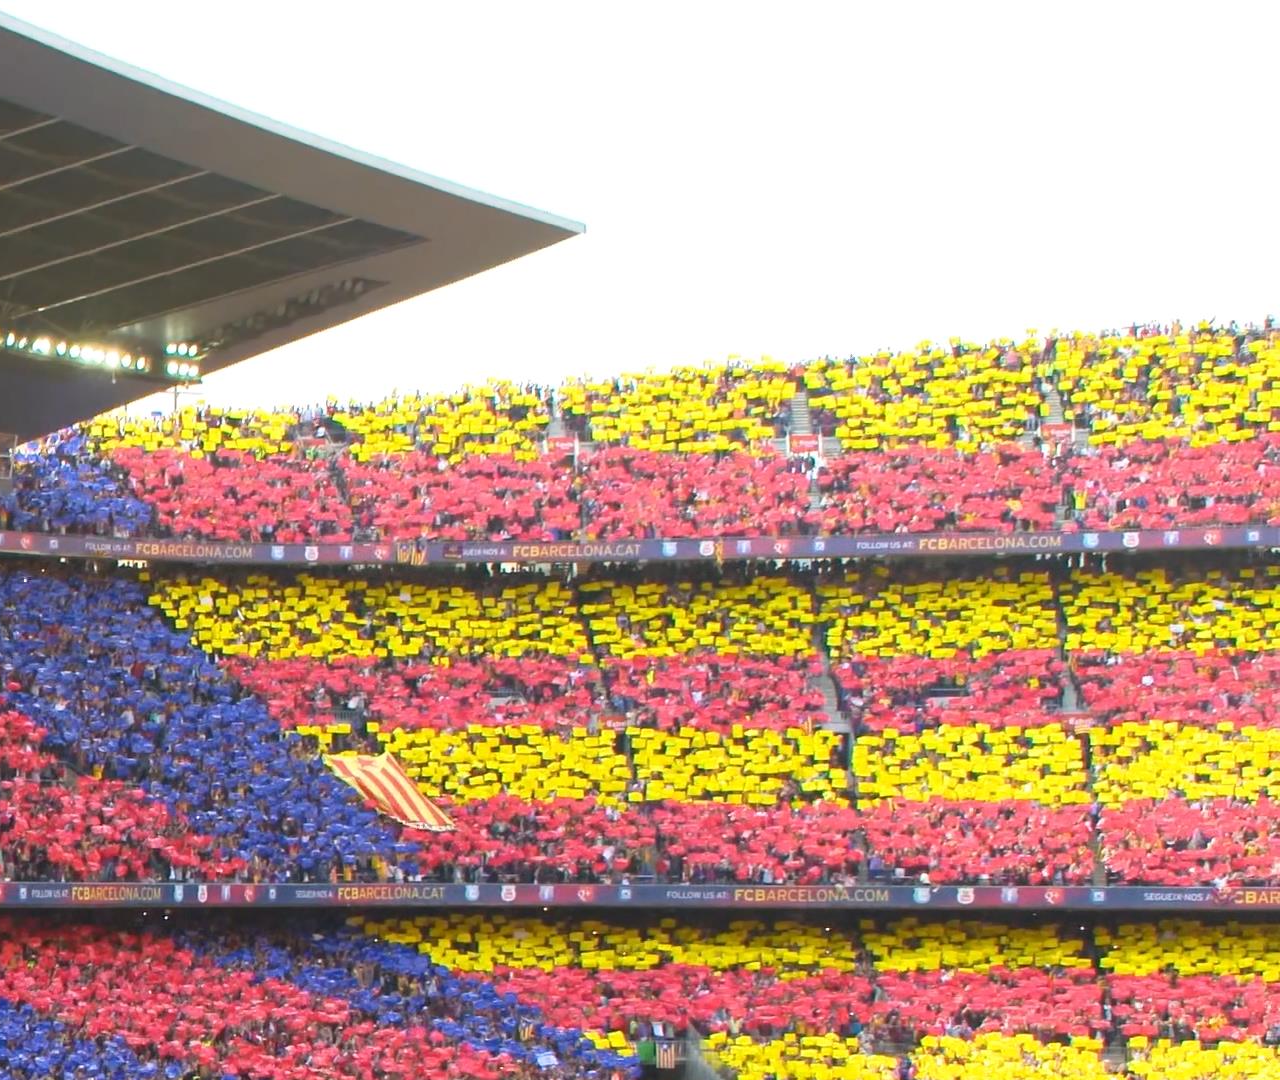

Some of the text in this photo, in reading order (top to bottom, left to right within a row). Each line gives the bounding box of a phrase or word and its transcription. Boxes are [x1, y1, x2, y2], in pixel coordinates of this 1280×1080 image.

[919, 535, 1061, 550] FCBARCELONA.COM
[71, 885, 162, 901] FCBARCELONA.COM
[338, 886, 445, 900] FCBARCELONA.CAT
[734, 888, 889, 902] FCBARCELONA.COM
